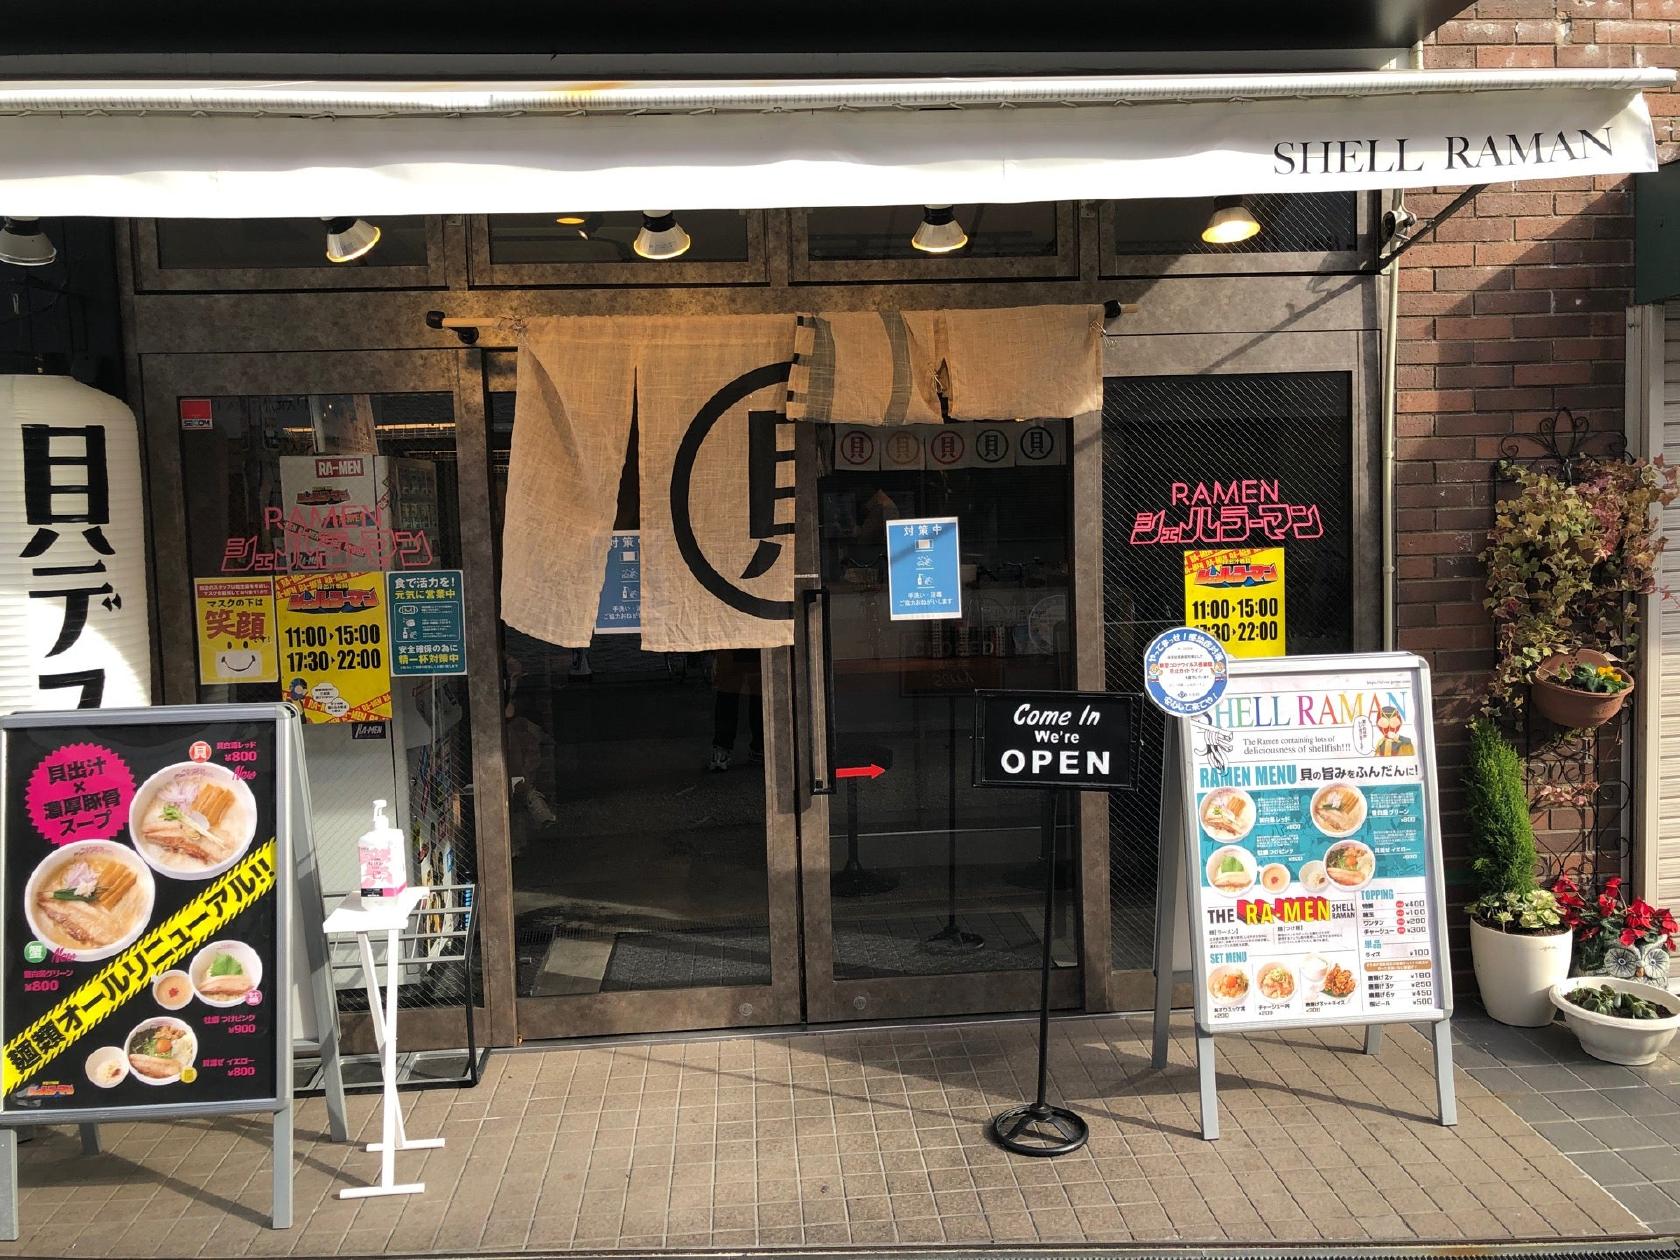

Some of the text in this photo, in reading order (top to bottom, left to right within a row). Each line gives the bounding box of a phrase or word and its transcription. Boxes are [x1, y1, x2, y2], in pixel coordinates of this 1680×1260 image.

[1274, 126, 1614, 175] SHELL RAMAN
[319, 461, 361, 476] RA-MEN
[1172, 480, 1279, 505] RAMEN
[264, 504, 382, 530] RAMEN
[1130, 504, 1324, 544] シェルラーマン
[904, 524, 942, 536] 対策中
[395, 577, 455, 588] 食で活力を!
[395, 589, 456, 600] 元気に営業中
[207, 599, 263, 607] マスクの下は
[1192, 598, 1278, 619] 11:00 15:00
[205, 609, 266, 640] 笑顔
[1237, 621, 1278, 641] 22:00
[285, 624, 380, 647] 11:00 15:00
[398, 645, 458, 654] 安全確保の為に
[287, 648, 381, 672] 17:30 22:00
[1013, 704, 1100, 726] Come In
[1203, 695, 1291, 729] HELL
[1034, 730, 1080, 743] We're
[1243, 738, 1256, 746] The
[1257, 737, 1279, 745] Ramen
[1281, 736, 1313, 745] containing
[225, 752, 257, 761] ¥800
[1244, 743, 1351, 755] deliciousness of shellfish!!!
[1001, 749, 1110, 775] OPEN
[48, 756, 107, 785] 貝出汁
[1199, 764, 1297, 788] RAMEN MENU
[1300, 764, 1418, 781] 貝の旨みをふんだんに!
[43, 787, 120, 820] 濃厚豚骨
[60, 809, 112, 836] スープ
[1361, 889, 1394, 901] TOPPING
[1332, 903, 1355, 912] SHELL
[1208, 908, 1235, 924] THE
[1332, 911, 1356, 920] RAMAN
[1210, 951, 1248, 964] SET MENU
[25, 980, 59, 991] ¥800
[228, 1024, 256, 1033] ¥900
[226, 1057, 256, 1065] イエロー
[227, 1067, 256, 1076] ¥800
